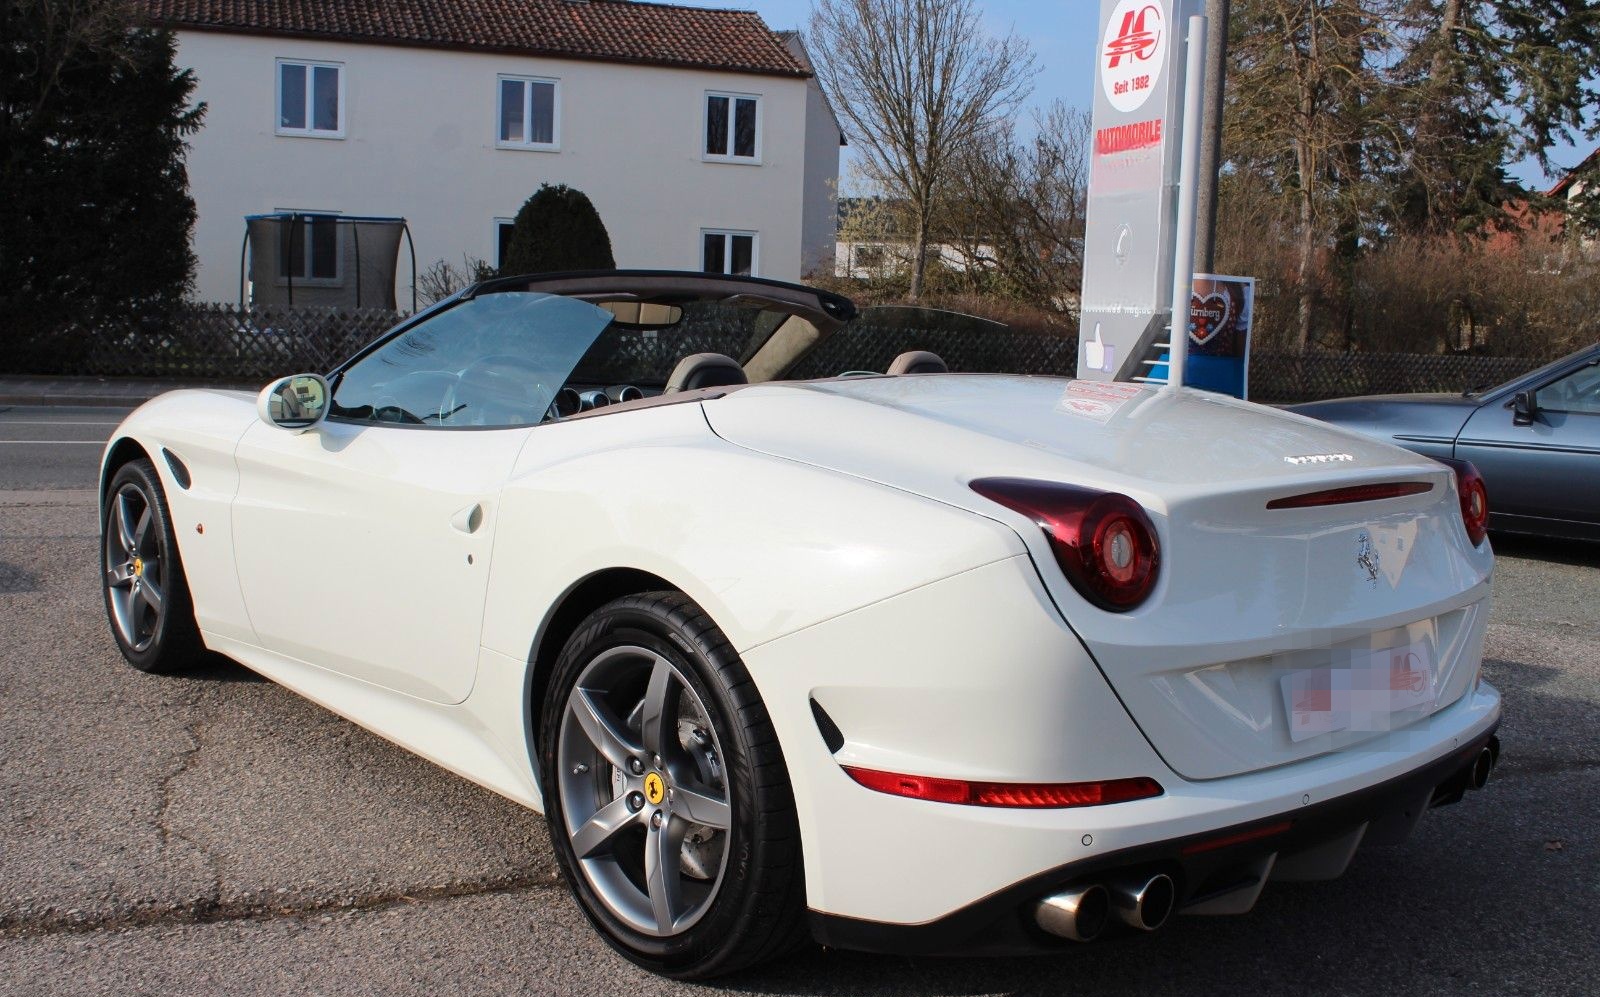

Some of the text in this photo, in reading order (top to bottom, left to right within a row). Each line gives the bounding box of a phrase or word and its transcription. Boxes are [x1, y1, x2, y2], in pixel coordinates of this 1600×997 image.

[1114, 75, 1150, 95] Seit 1982
[1096, 118, 1162, 154] AUTOMOBILE
[1190, 305, 1220, 321] ürnberg
